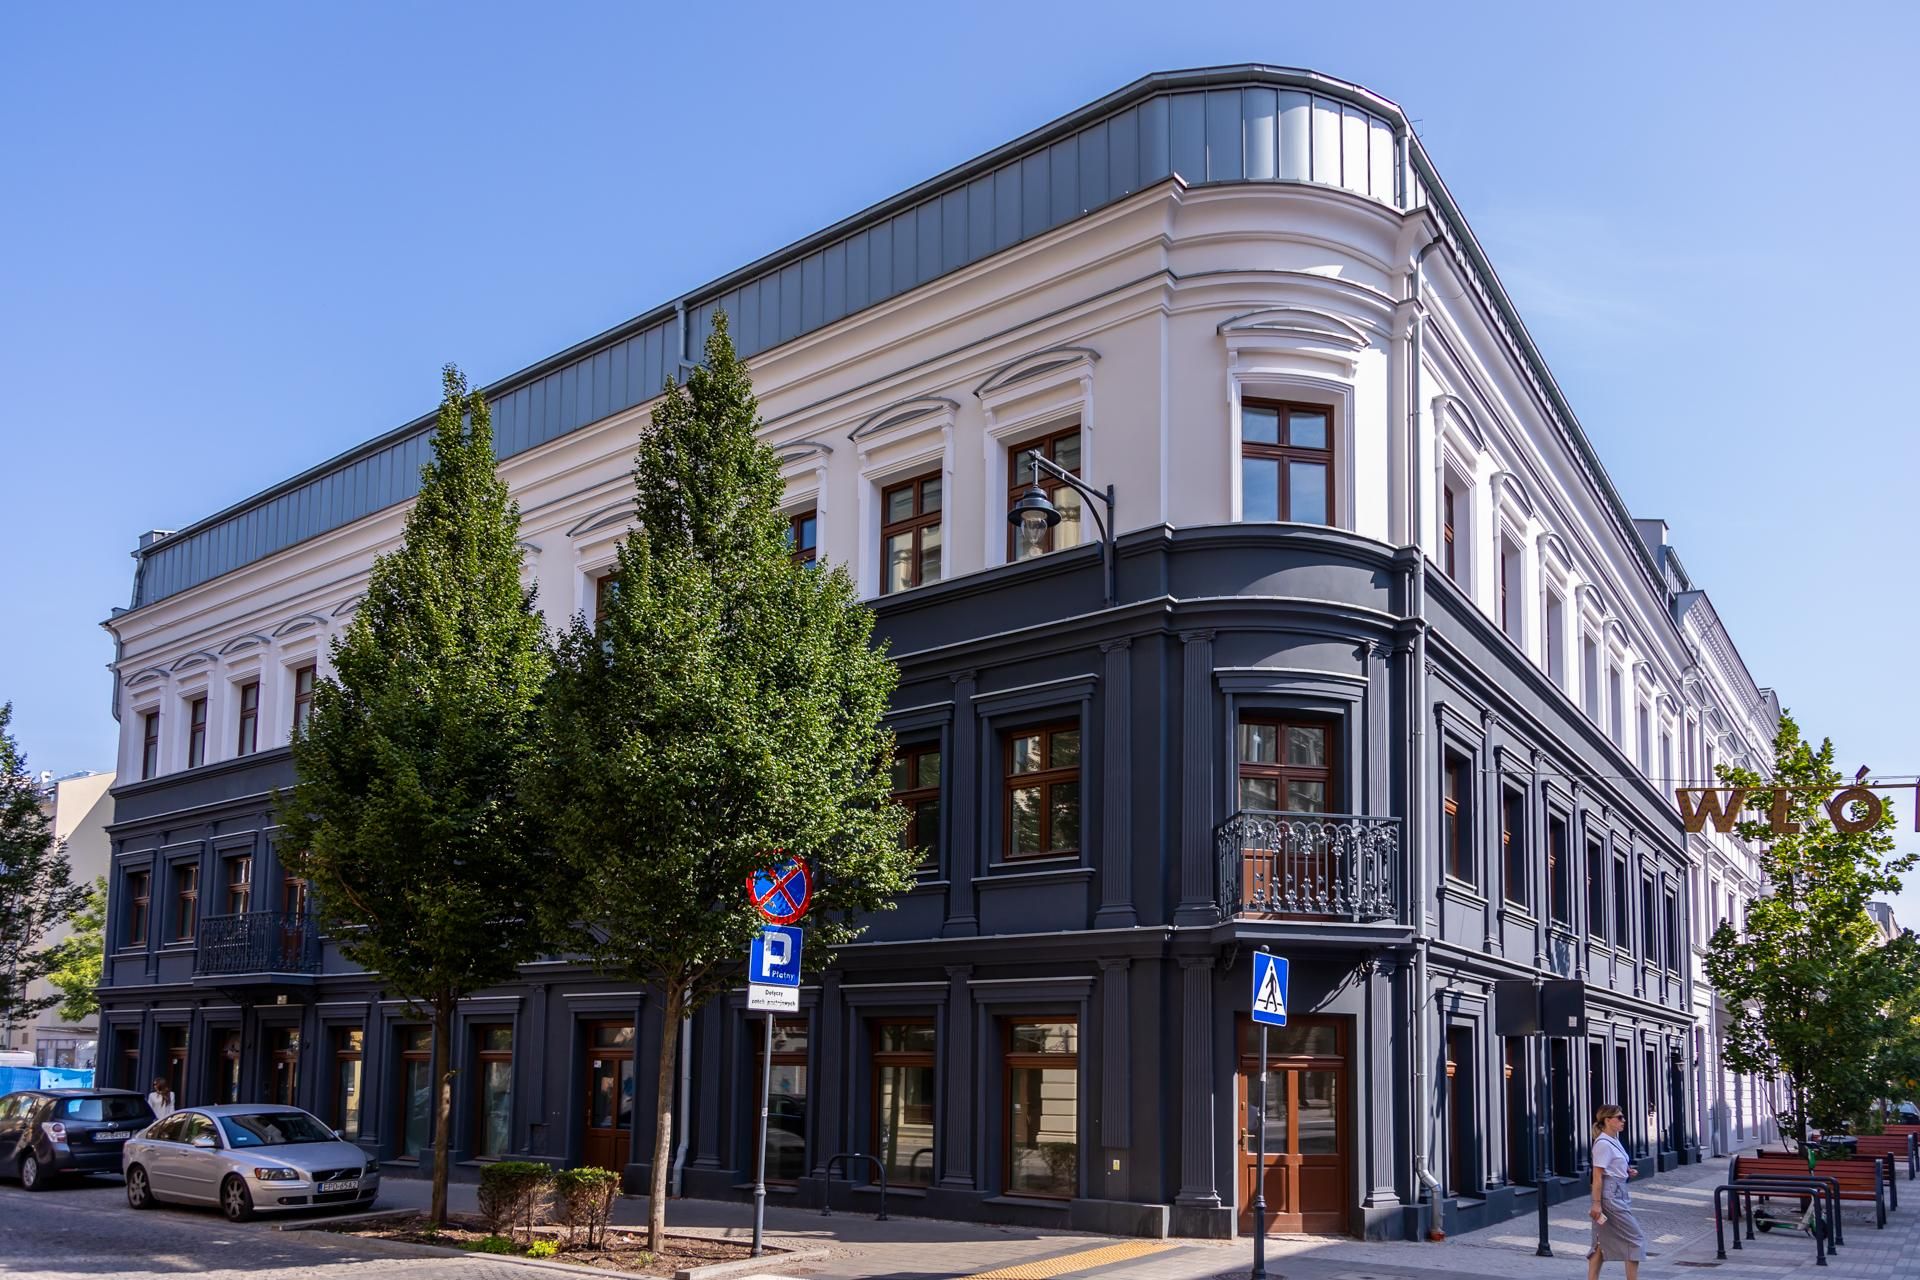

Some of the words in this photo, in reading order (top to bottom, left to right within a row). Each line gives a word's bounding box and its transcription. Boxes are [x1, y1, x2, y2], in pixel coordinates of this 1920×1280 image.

[1676, 765, 1920, 833] WŁÓ
[762, 931, 792, 977] P
[765, 989, 784, 997] Dotyczy
